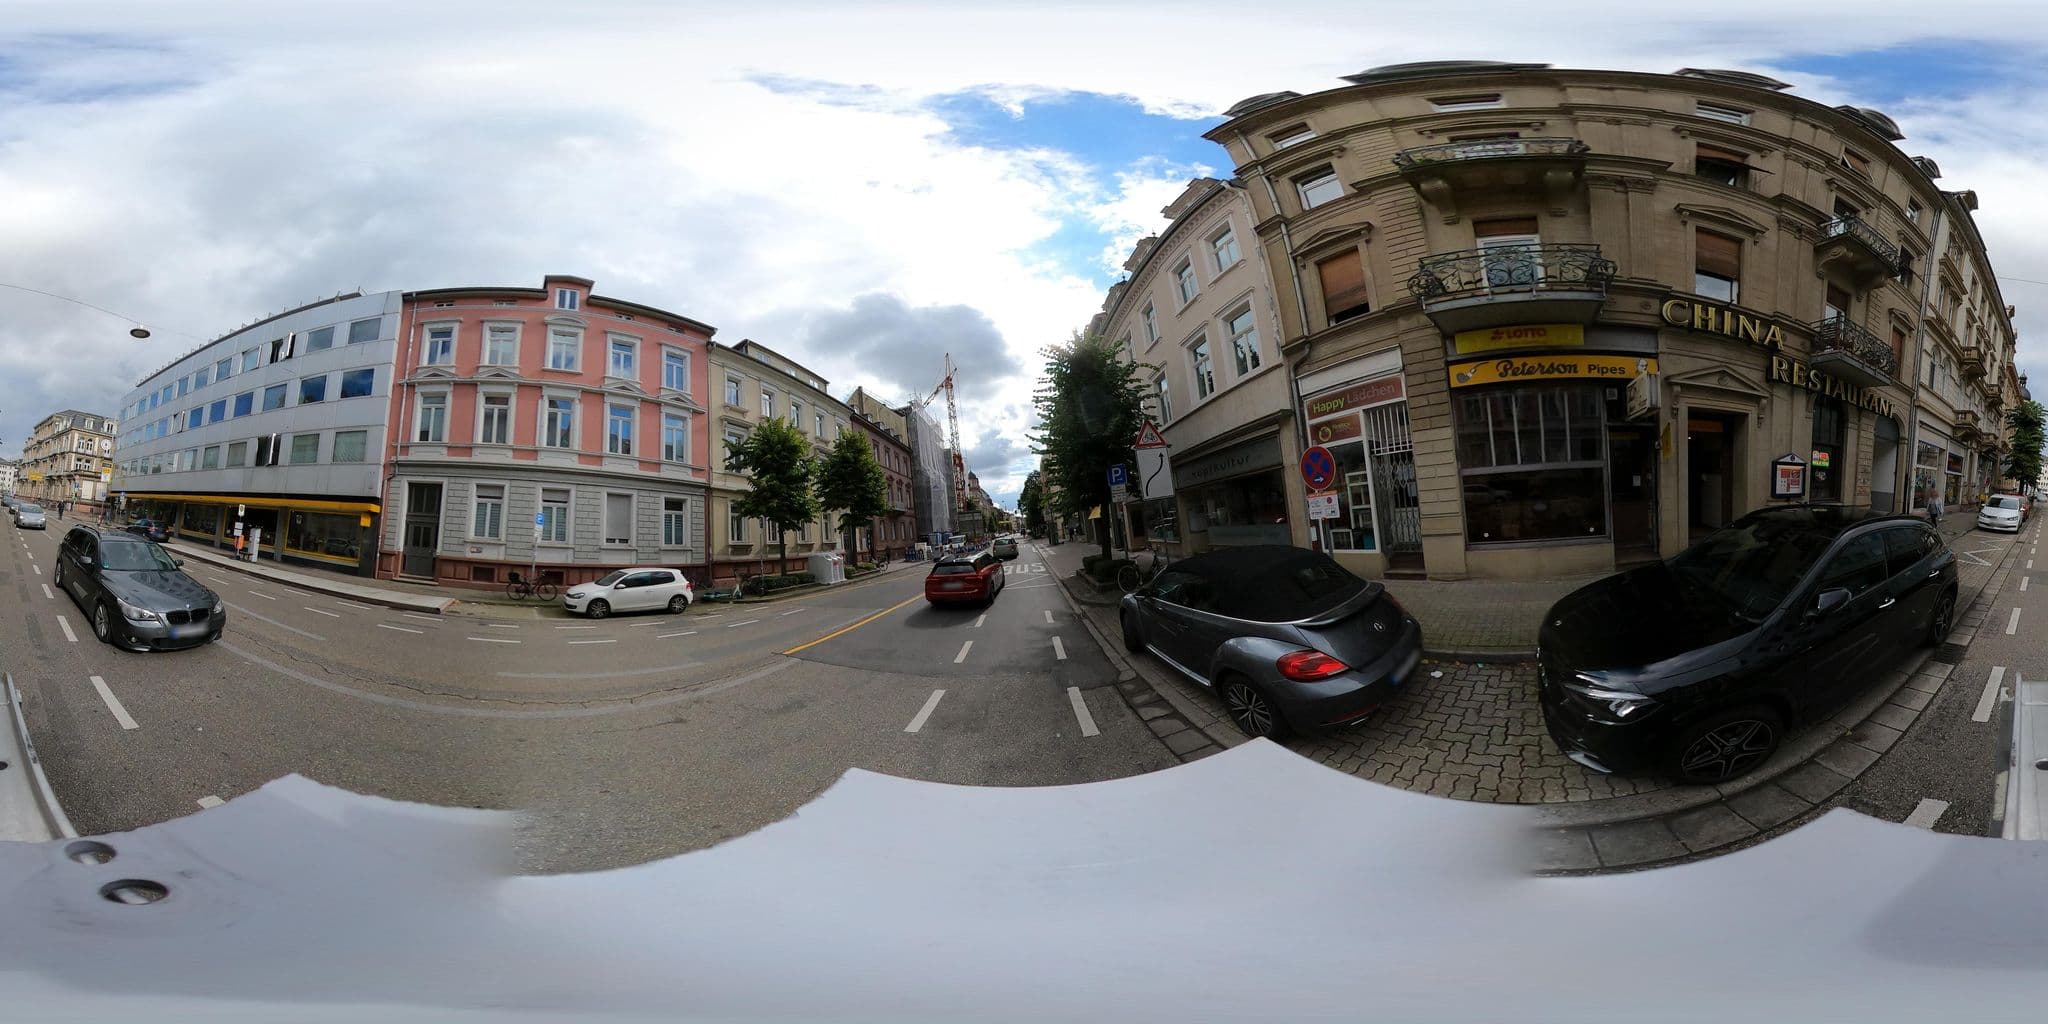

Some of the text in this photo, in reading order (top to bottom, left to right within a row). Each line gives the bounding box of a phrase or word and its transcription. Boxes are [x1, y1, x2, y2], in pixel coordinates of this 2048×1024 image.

[1508, 327, 1547, 339] LOTTO
[1661, 299, 1785, 352] CHINA
[1496, 359, 1626, 378] Peterson Pipes
[1312, 383, 1396, 415] Happy Lädchen
[1771, 355, 1897, 419] RESTAURANT
[1111, 467, 1121, 483] P
